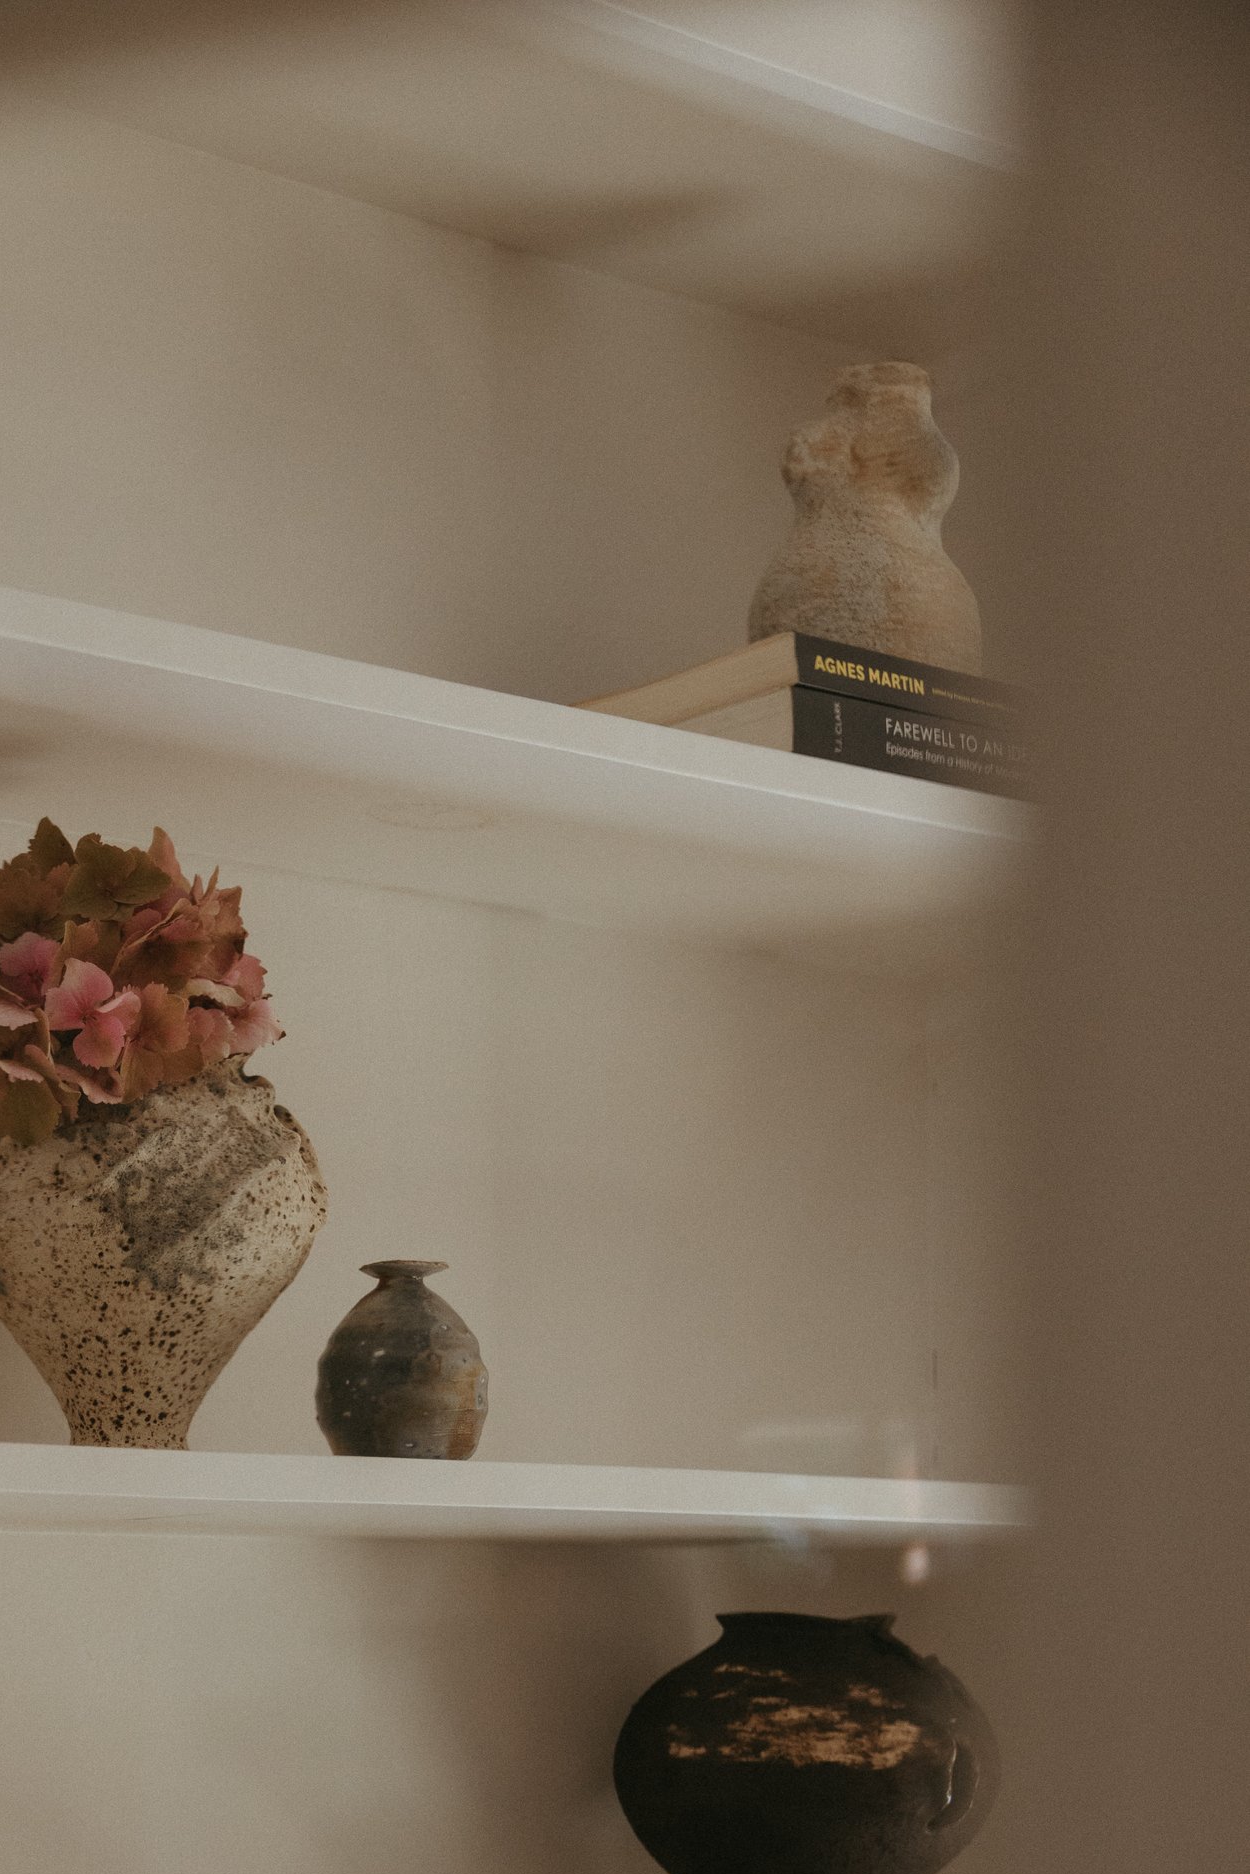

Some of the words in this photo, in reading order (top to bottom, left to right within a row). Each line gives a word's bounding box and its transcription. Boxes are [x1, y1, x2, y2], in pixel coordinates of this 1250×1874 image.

[814, 655, 865, 682] AGNES
[869, 666, 925, 696] MARTIN
[885, 718, 956, 750] FAREWELL
[960, 733, 978, 752] TO
[982, 740, 1004, 757] AN
[885, 741, 924, 761] Episodes
[924, 749, 946, 764] from
